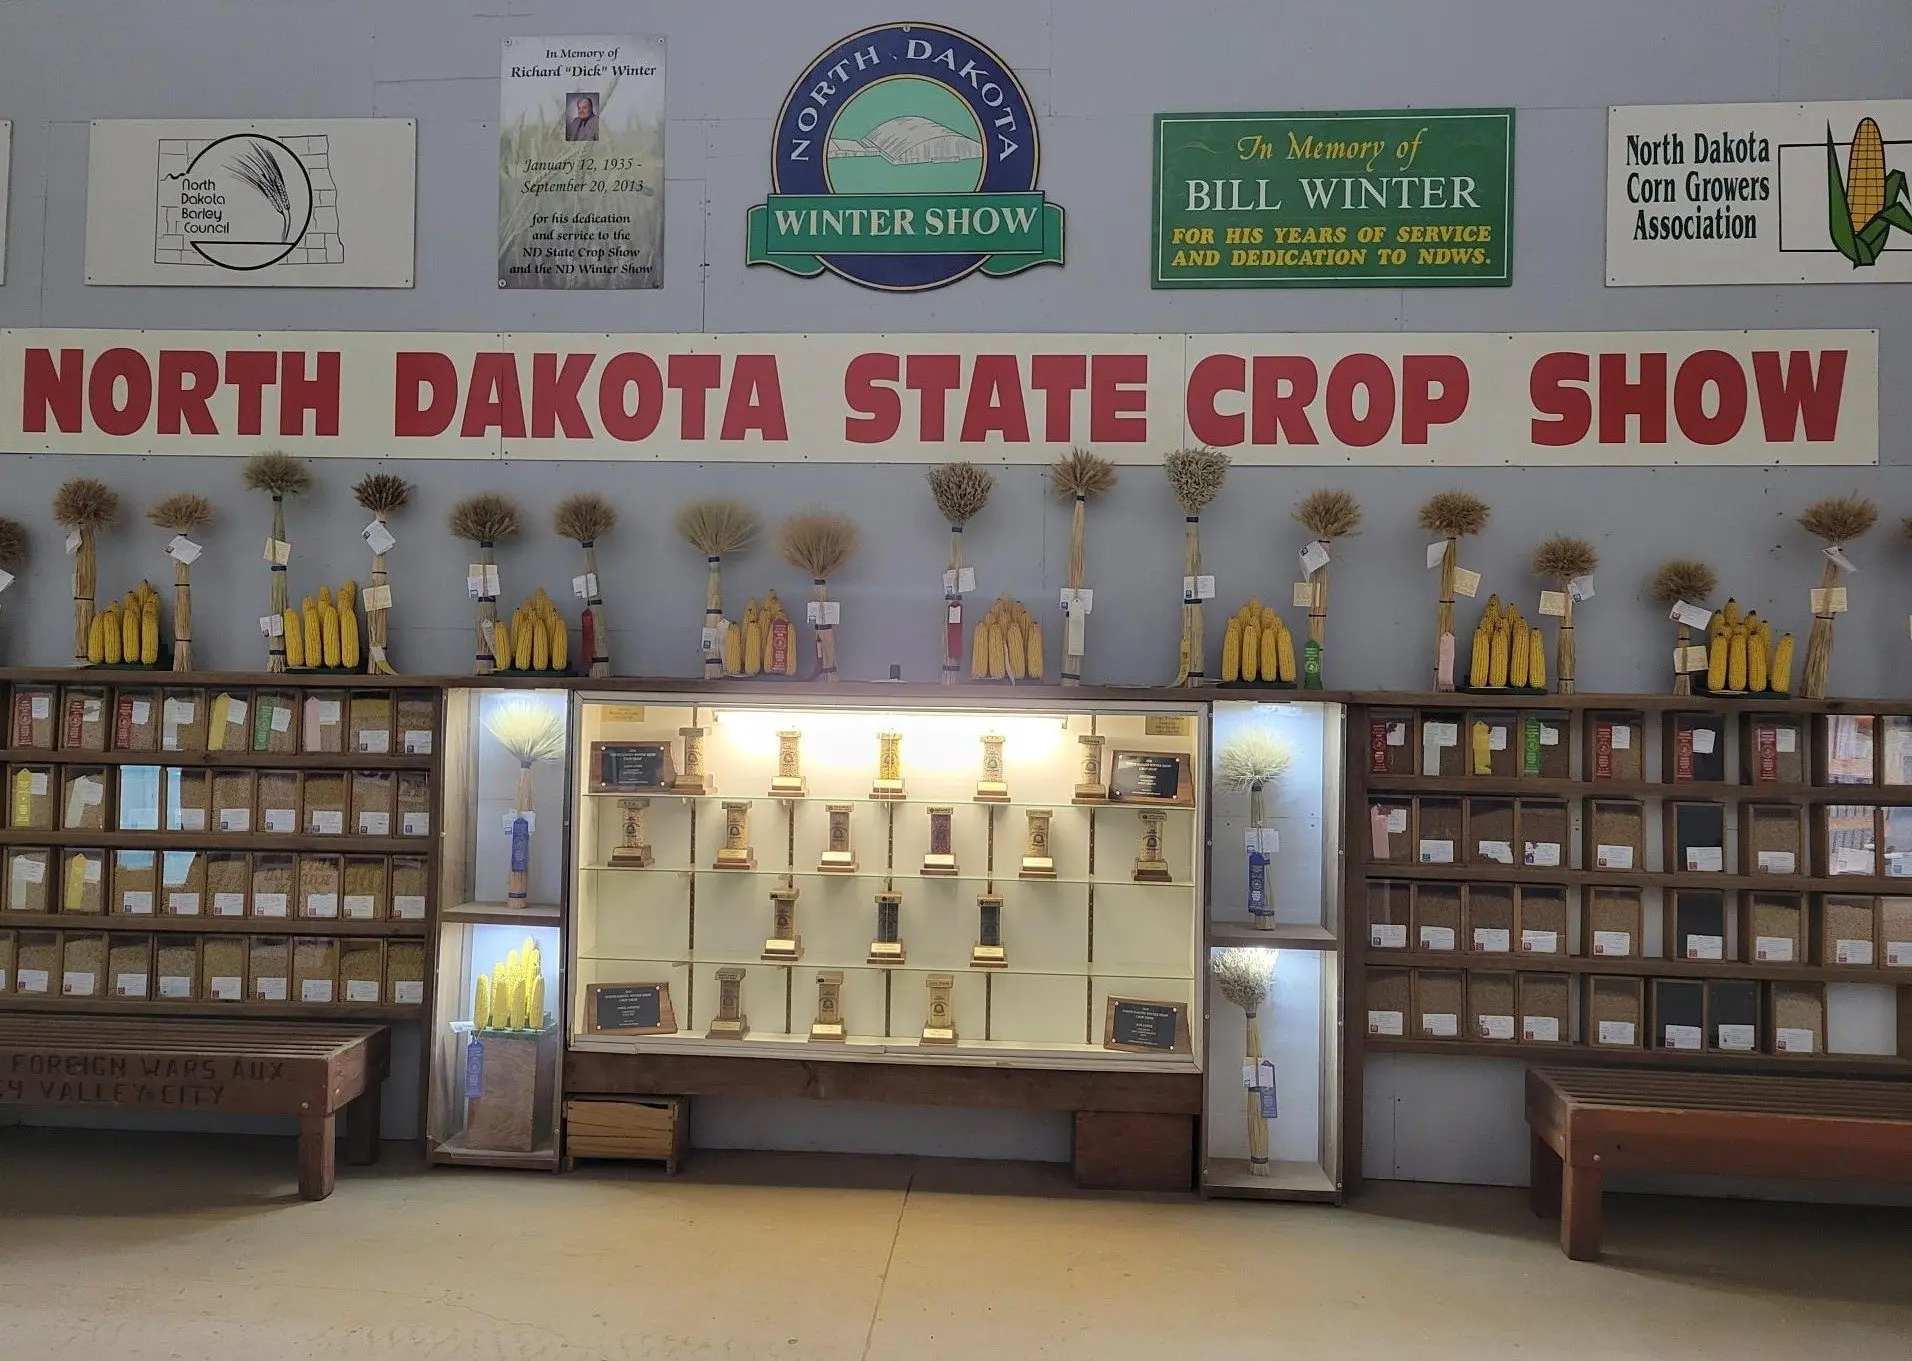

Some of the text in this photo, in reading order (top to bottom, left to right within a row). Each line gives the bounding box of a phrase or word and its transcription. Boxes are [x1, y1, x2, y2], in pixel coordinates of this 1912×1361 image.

[545, 47, 620, 62] In Memory of
[511, 65, 562, 78] Richard
[612, 65, 656, 76] Winter
[790, 39, 1020, 162] NORTH DAKOTA
[1236, 128, 1428, 173] In Memory of
[1626, 131, 1771, 166] North Dakota
[522, 158, 576, 174] January
[579, 158, 597, 172] 12,
[604, 158, 634, 170] 1935
[182, 178, 216, 191] North
[521, 178, 644, 196] September 20, 2013
[1627, 171, 1770, 204] Corn Growers
[181, 192, 226, 205] Dakota
[1184, 176, 1480, 212] BILL WINTER
[182, 207, 222, 222] Barley
[530, 212, 631, 228] for his dedication
[774, 207, 1038, 236] WINTER SHOW
[1633, 204, 1758, 240] Association
[184, 221, 230, 234] Council
[532, 230, 630, 240] and service to the
[1171, 226, 1492, 245] FOR HIS YEARS OF SERVICE
[522, 246, 640, 261] ND State Crop Show
[1170, 248, 1492, 266] AND DEDICATION TO NDWS.
[509, 264, 652, 275] and the ND Winter Show
[22, 347, 1849, 447] NORTH DAKOTA STATE CROP SHOW
[11, 1053, 126, 1077] FOREIGN
[140, 1057, 217, 1080] WARS
[40, 1080, 146, 1104] VALLEY
[161, 1083, 225, 1106] CITY
